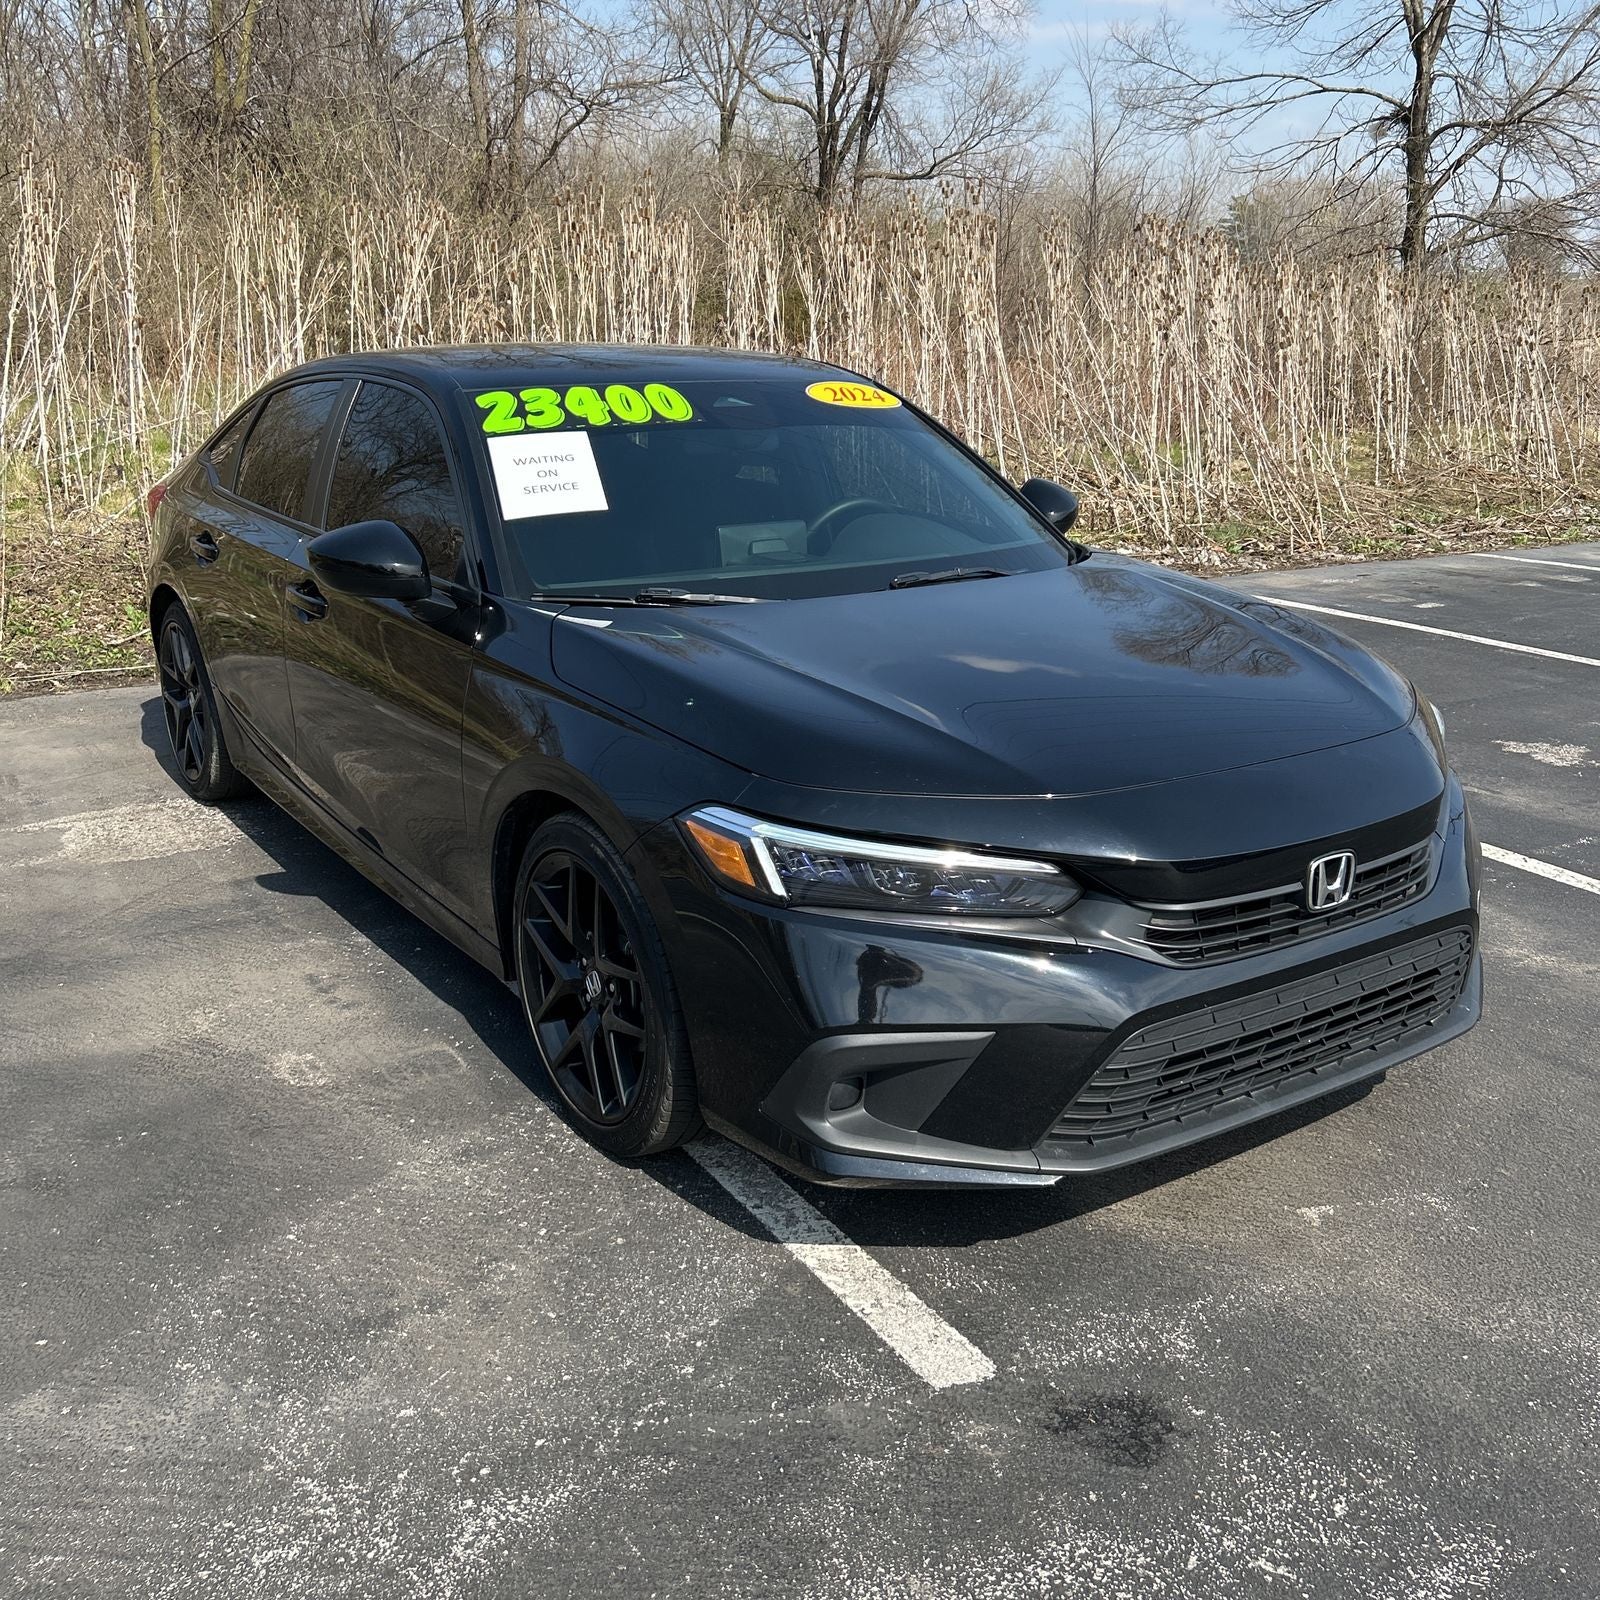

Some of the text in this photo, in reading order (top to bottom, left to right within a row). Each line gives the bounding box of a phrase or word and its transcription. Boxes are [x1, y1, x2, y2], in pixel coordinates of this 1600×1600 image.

[825, 387, 885, 402] 2024
[475, 383, 692, 433] 23400
[512, 454, 575, 466] WAITING
[536, 469, 558, 478] ON
[523, 482, 580, 495] SERVICE
